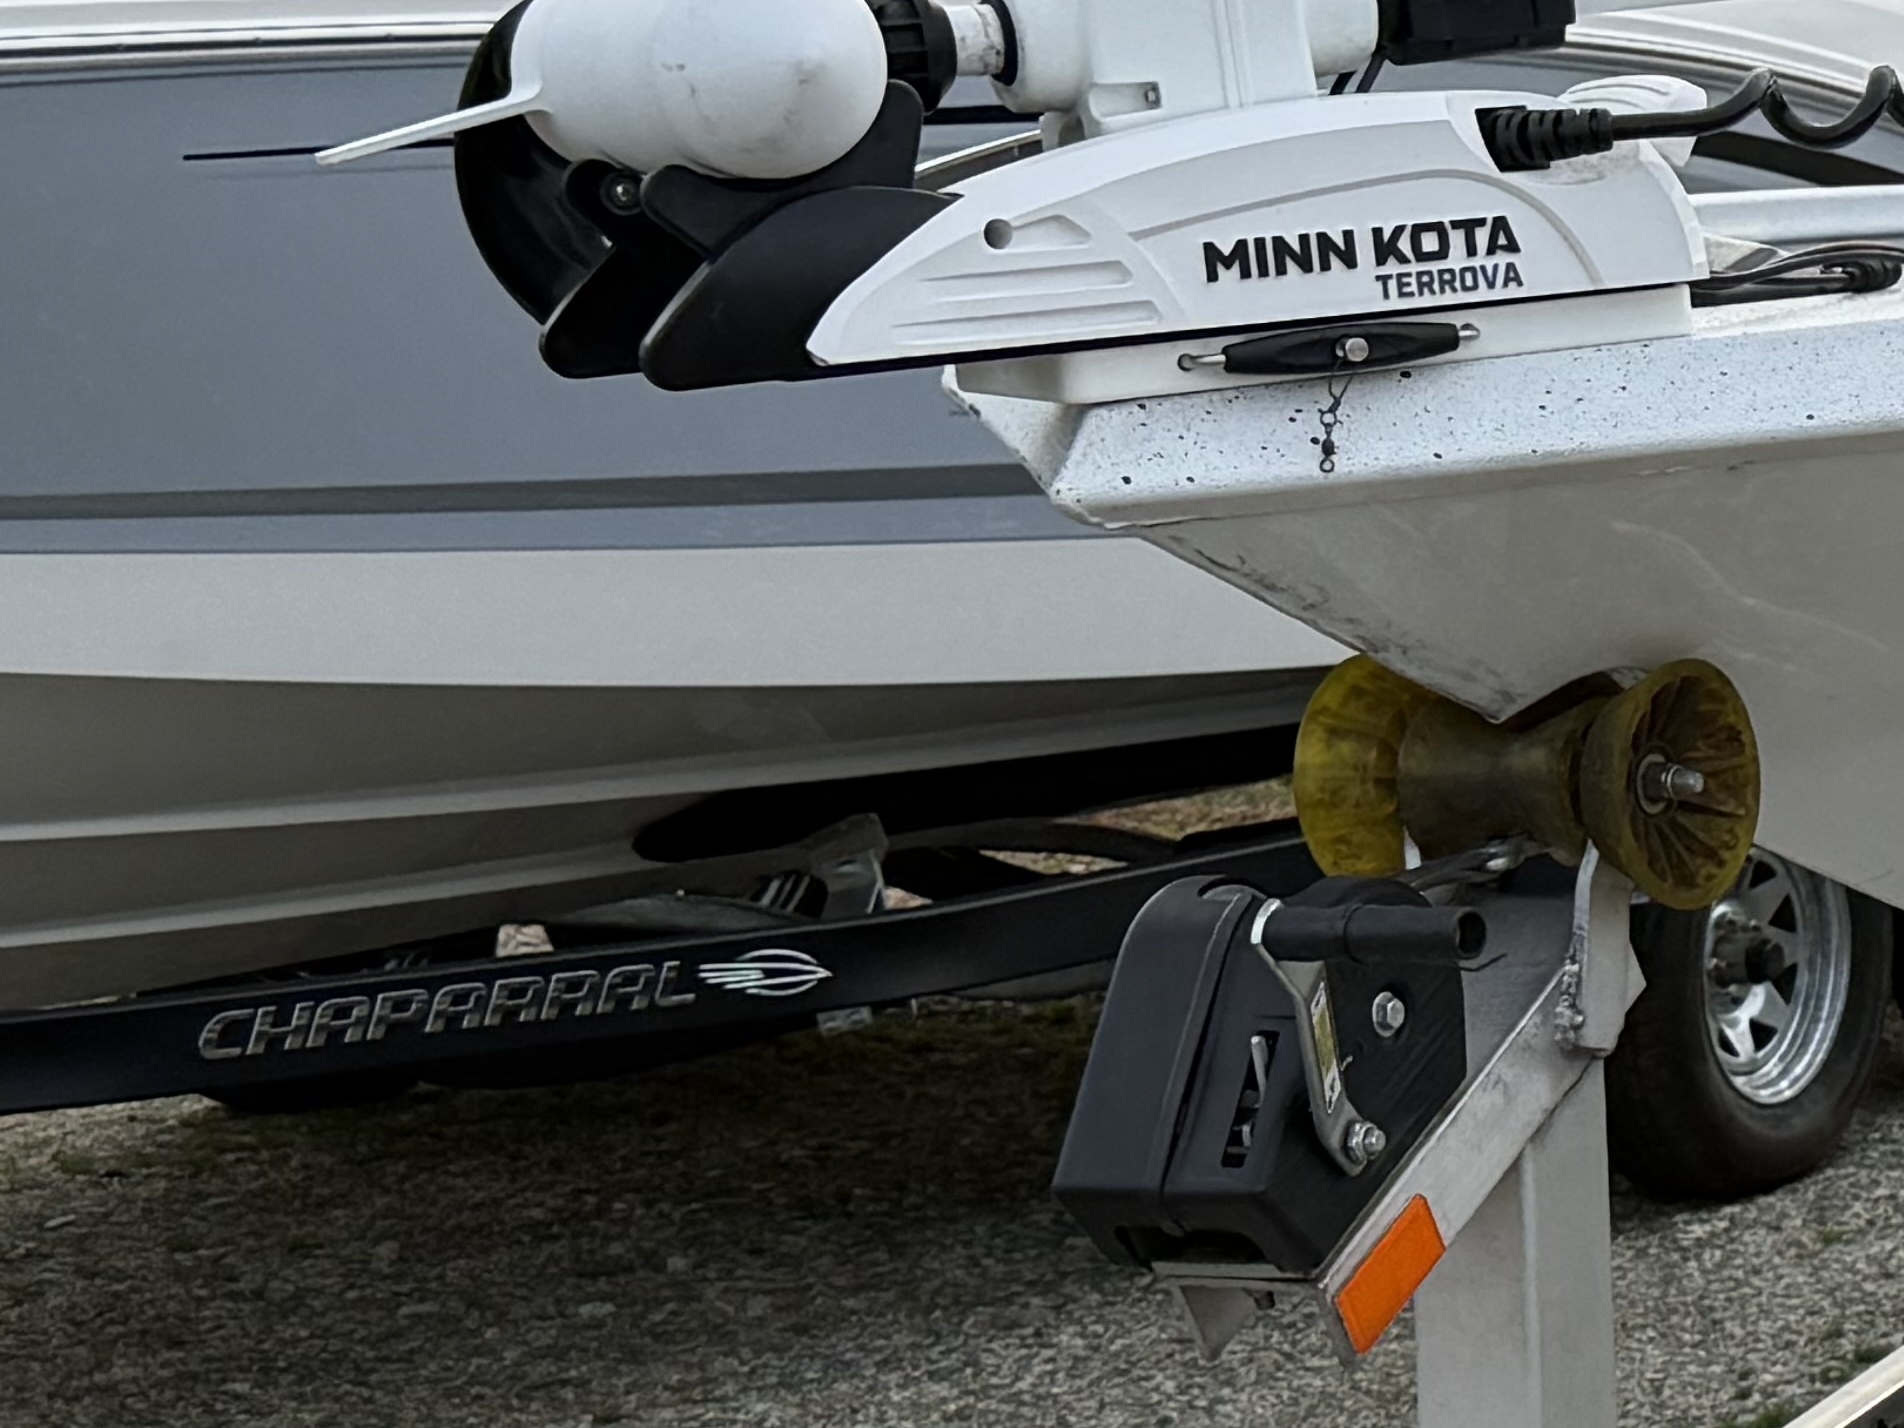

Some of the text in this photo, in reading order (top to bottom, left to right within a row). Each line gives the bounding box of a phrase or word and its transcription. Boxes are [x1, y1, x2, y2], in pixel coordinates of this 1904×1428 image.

[1202, 215, 1522, 283] MINN KOTA
[1375, 263, 1525, 300] TERROVA
[198, 960, 696, 1060] CHAPARRAL
